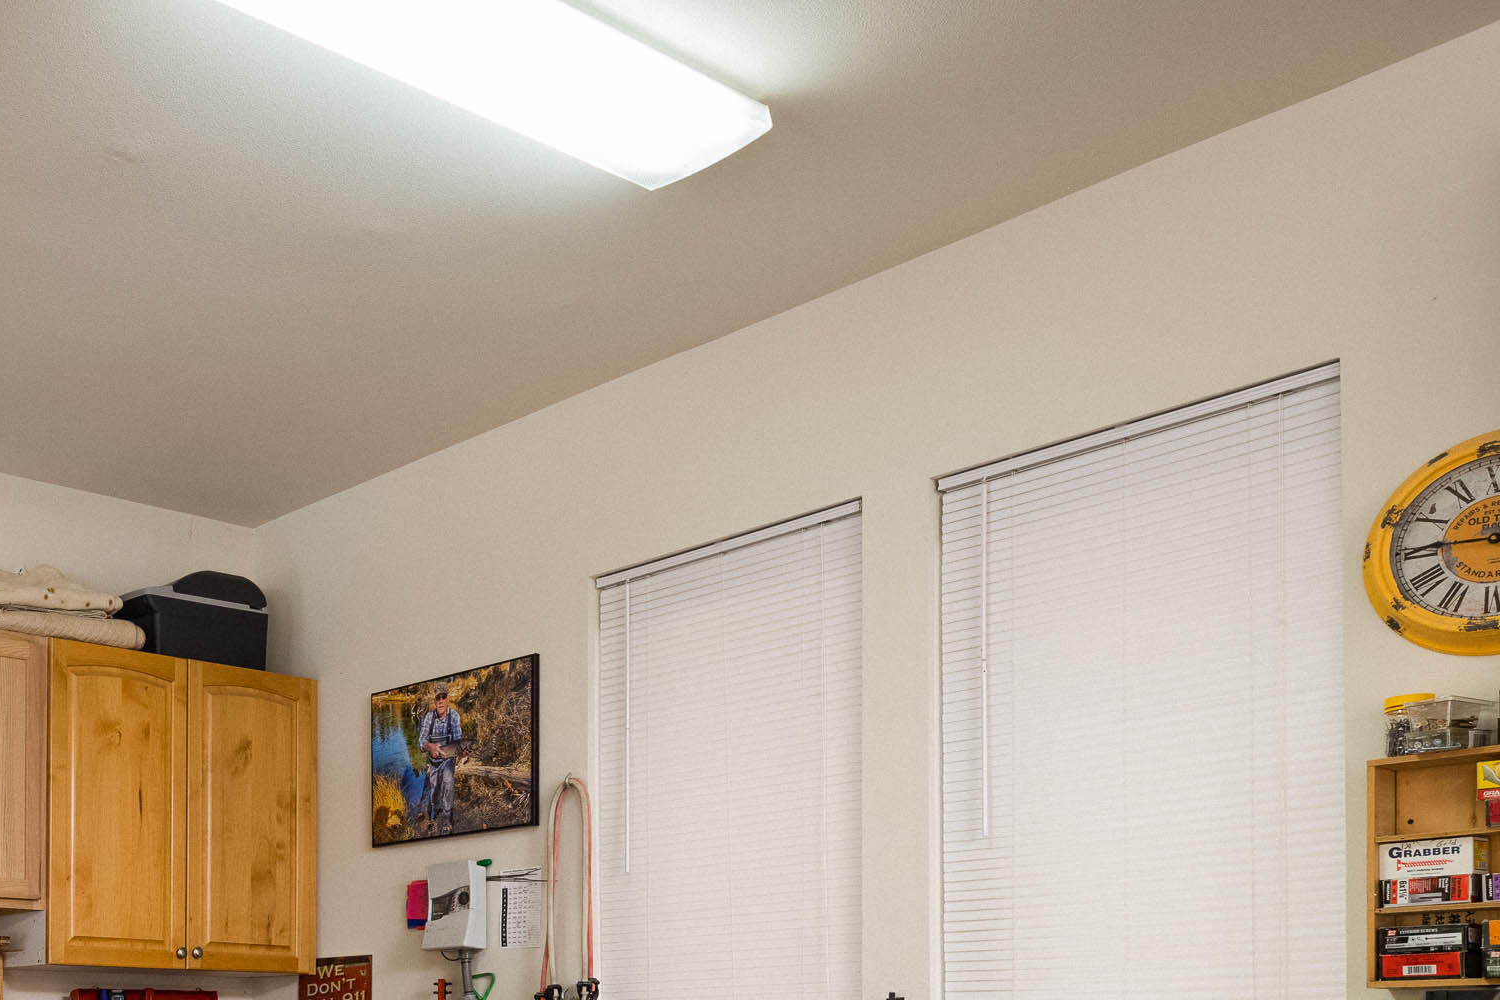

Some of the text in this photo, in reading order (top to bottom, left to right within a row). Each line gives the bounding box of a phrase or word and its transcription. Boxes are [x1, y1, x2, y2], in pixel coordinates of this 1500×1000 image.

[1467, 515, 1491, 526] OLD
[1456, 561, 1500, 579] STANDAR
[1388, 846, 1461, 859] GRABBER
[317, 964, 345, 979] WE
[307, 978, 357, 997] DON'T
